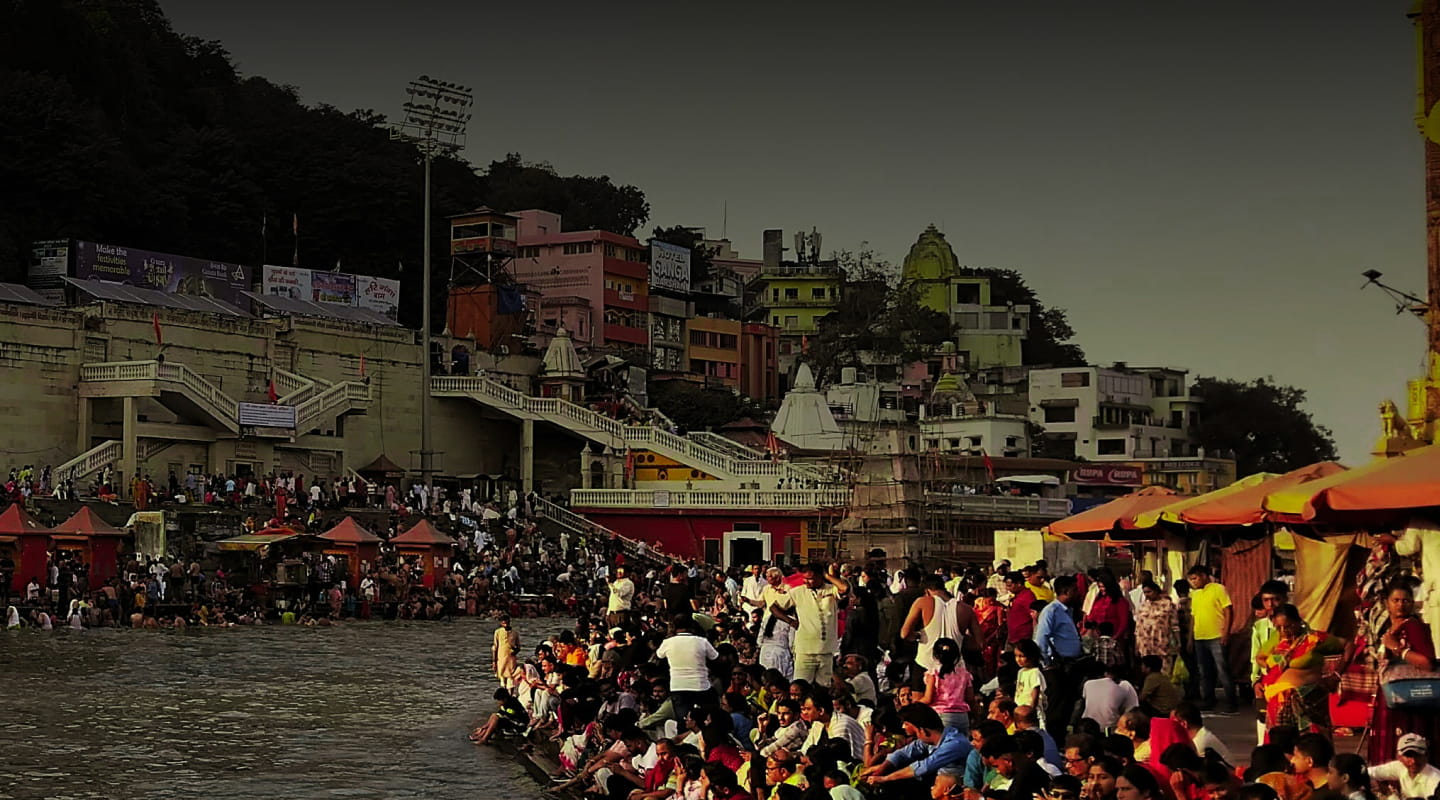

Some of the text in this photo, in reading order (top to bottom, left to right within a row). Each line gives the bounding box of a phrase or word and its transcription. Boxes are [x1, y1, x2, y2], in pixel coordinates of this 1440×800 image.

[95, 243, 128, 257] Make the
[653, 260, 689, 283] GANGA
